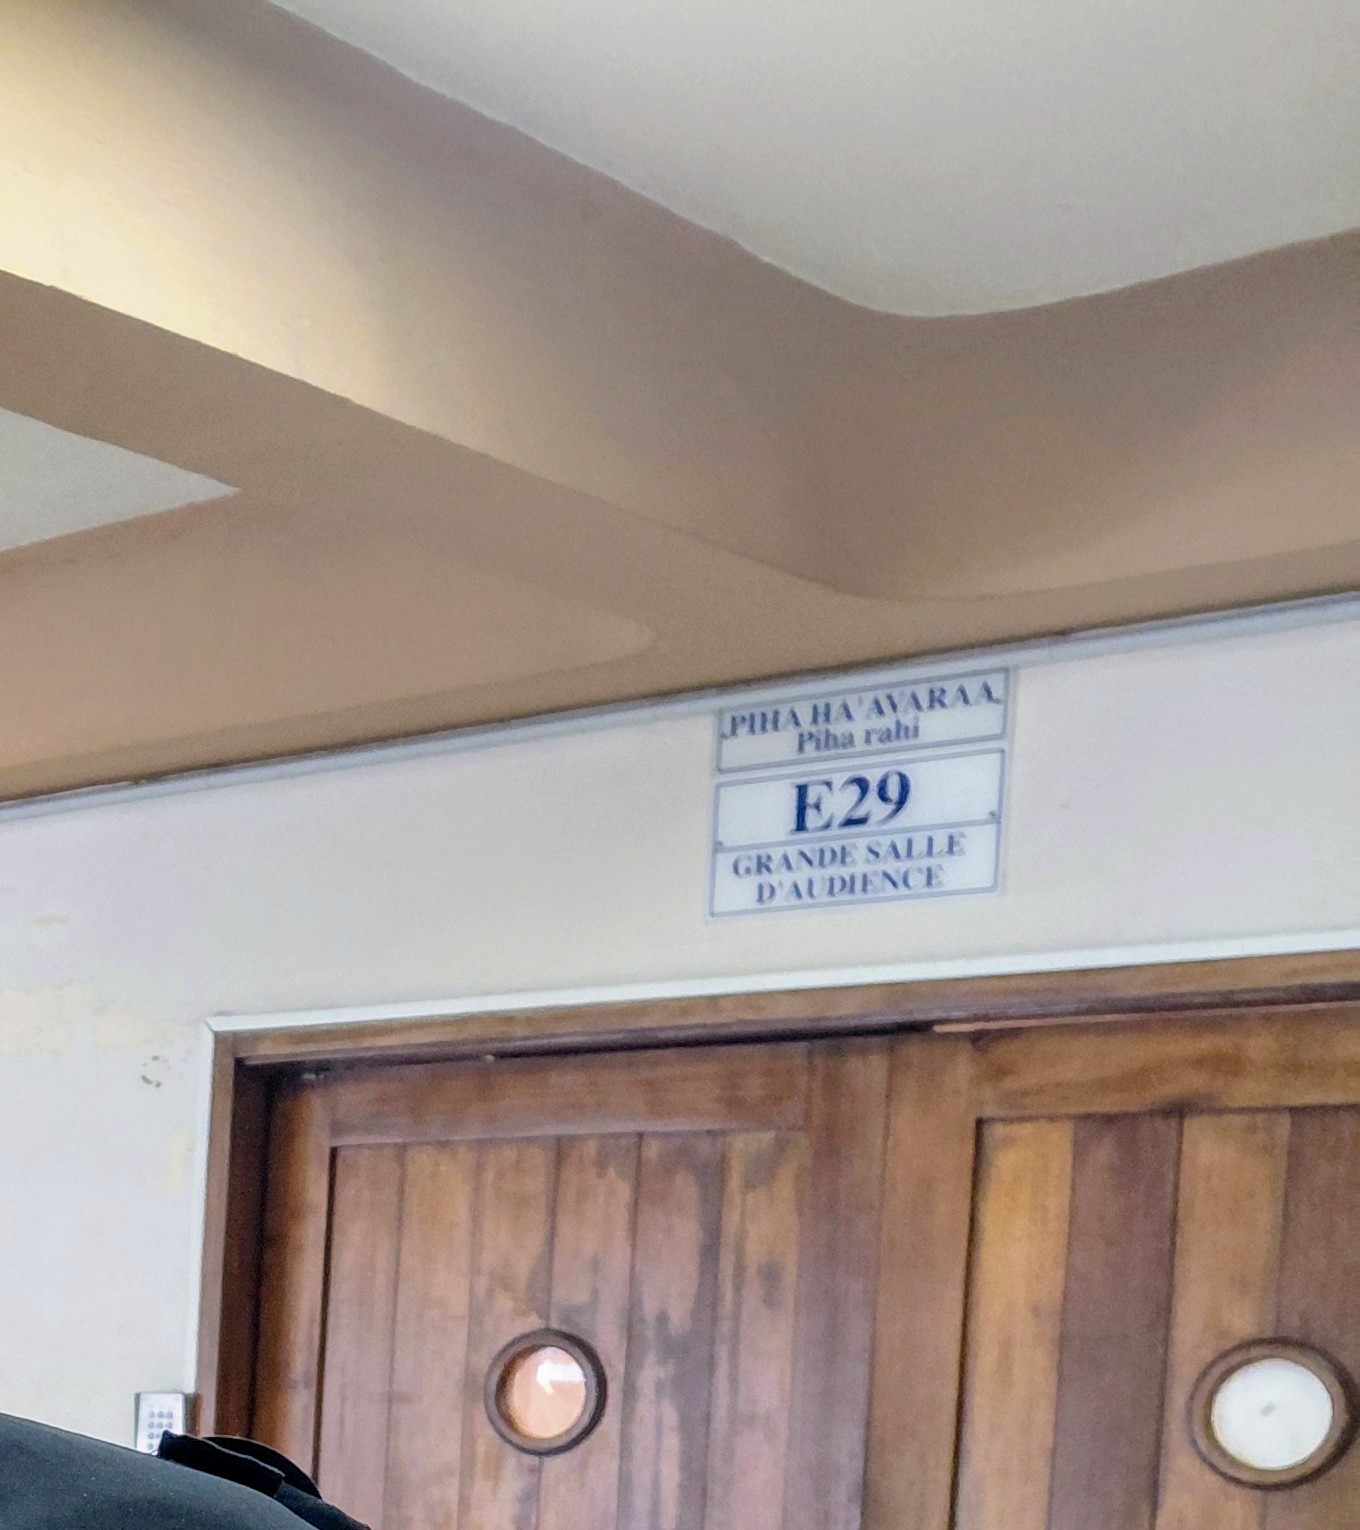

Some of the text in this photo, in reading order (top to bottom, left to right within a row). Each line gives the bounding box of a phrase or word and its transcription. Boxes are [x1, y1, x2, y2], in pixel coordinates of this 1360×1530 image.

[729, 706, 802, 738] PIHA
[796, 716, 921, 755] Piha rahi
[788, 769, 912, 836] E29
[732, 831, 969, 879] GRANDE SALLE
[754, 864, 946, 906] D'AUDIENCE
